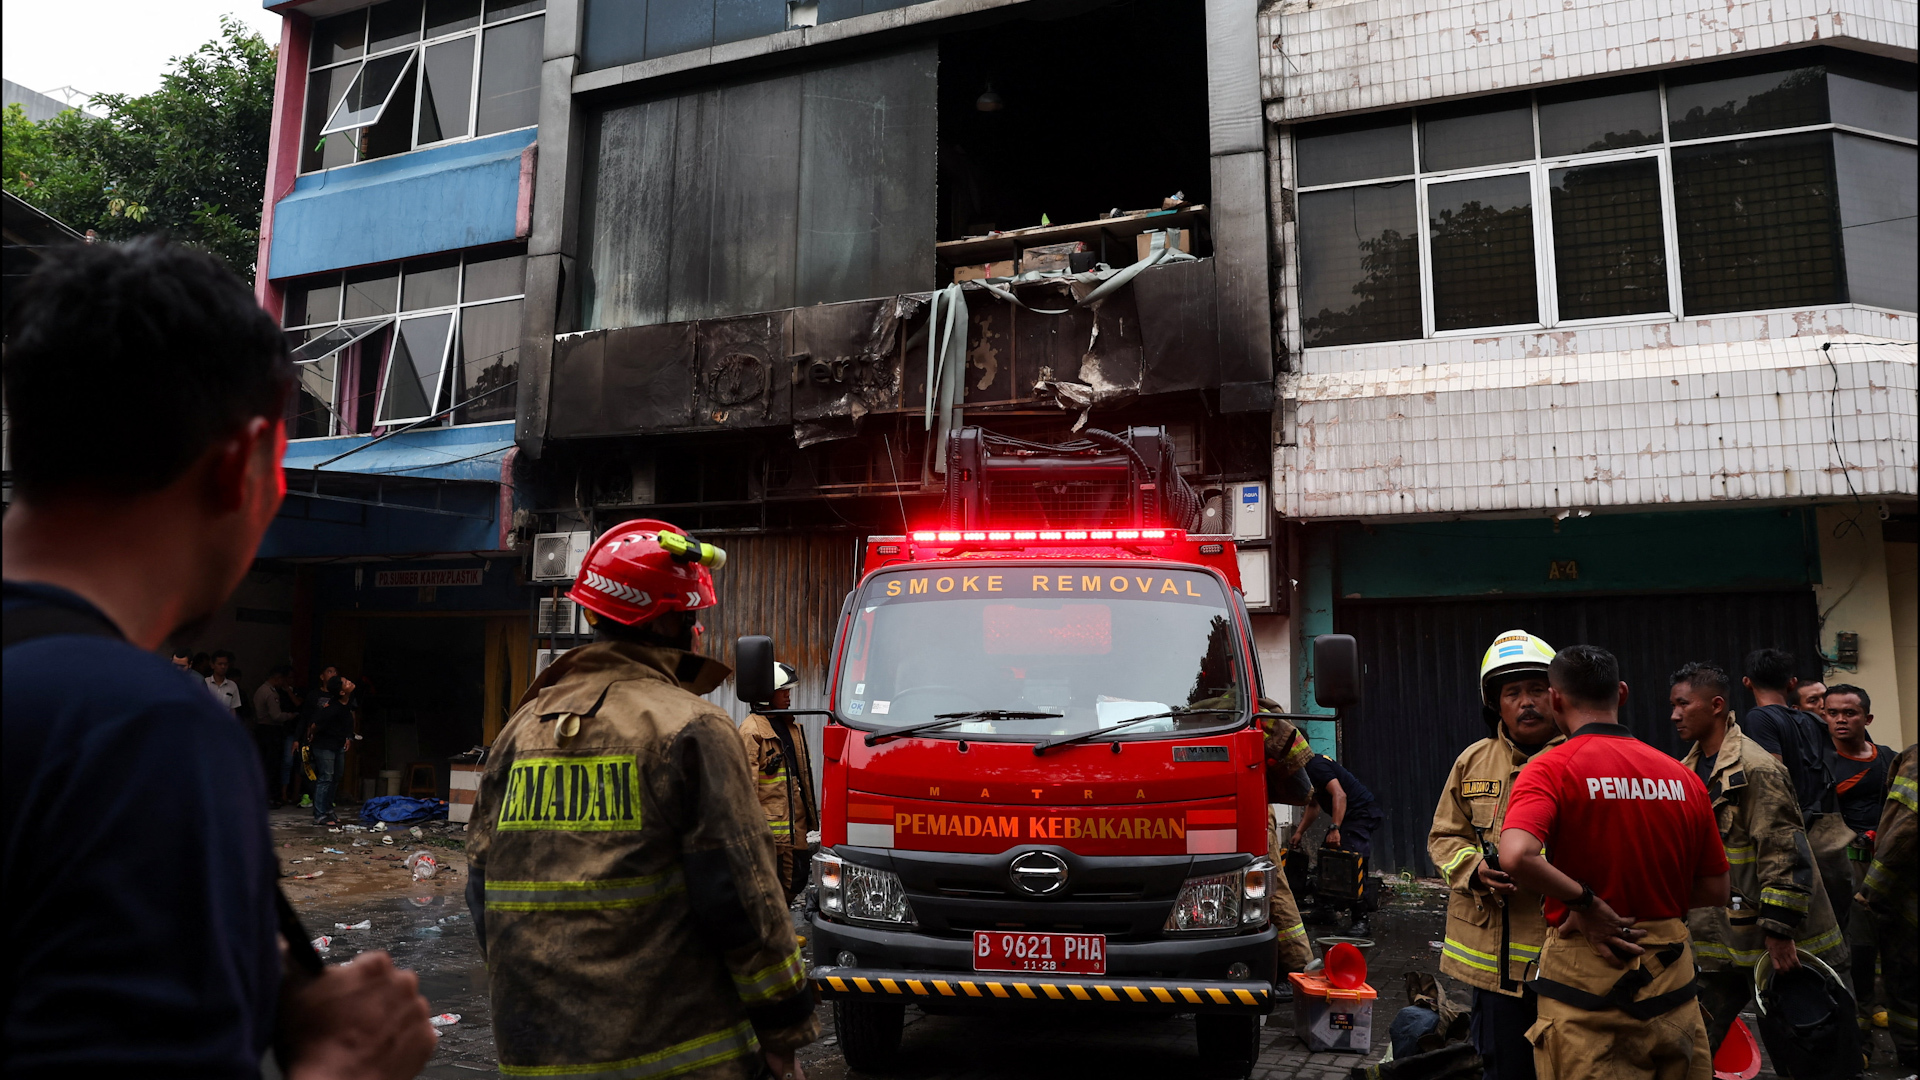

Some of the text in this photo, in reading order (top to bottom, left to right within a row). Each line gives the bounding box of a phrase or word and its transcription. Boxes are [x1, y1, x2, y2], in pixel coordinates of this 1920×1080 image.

[446, 570, 478, 584] PLASTIK
[1549, 560, 1578, 579] A-4
[886, 575, 1201, 597] SMOKE REMOVAL
[851, 702, 863, 711] OK
[502, 762, 633, 822] EMADAM
[929, 786, 1145, 799] MATRA
[1586, 777, 1686, 801] PEMADAM
[895, 812, 1185, 839] PEMADAM KEBAKARAN
[978, 934, 1102, 960] B 9621 PHA
